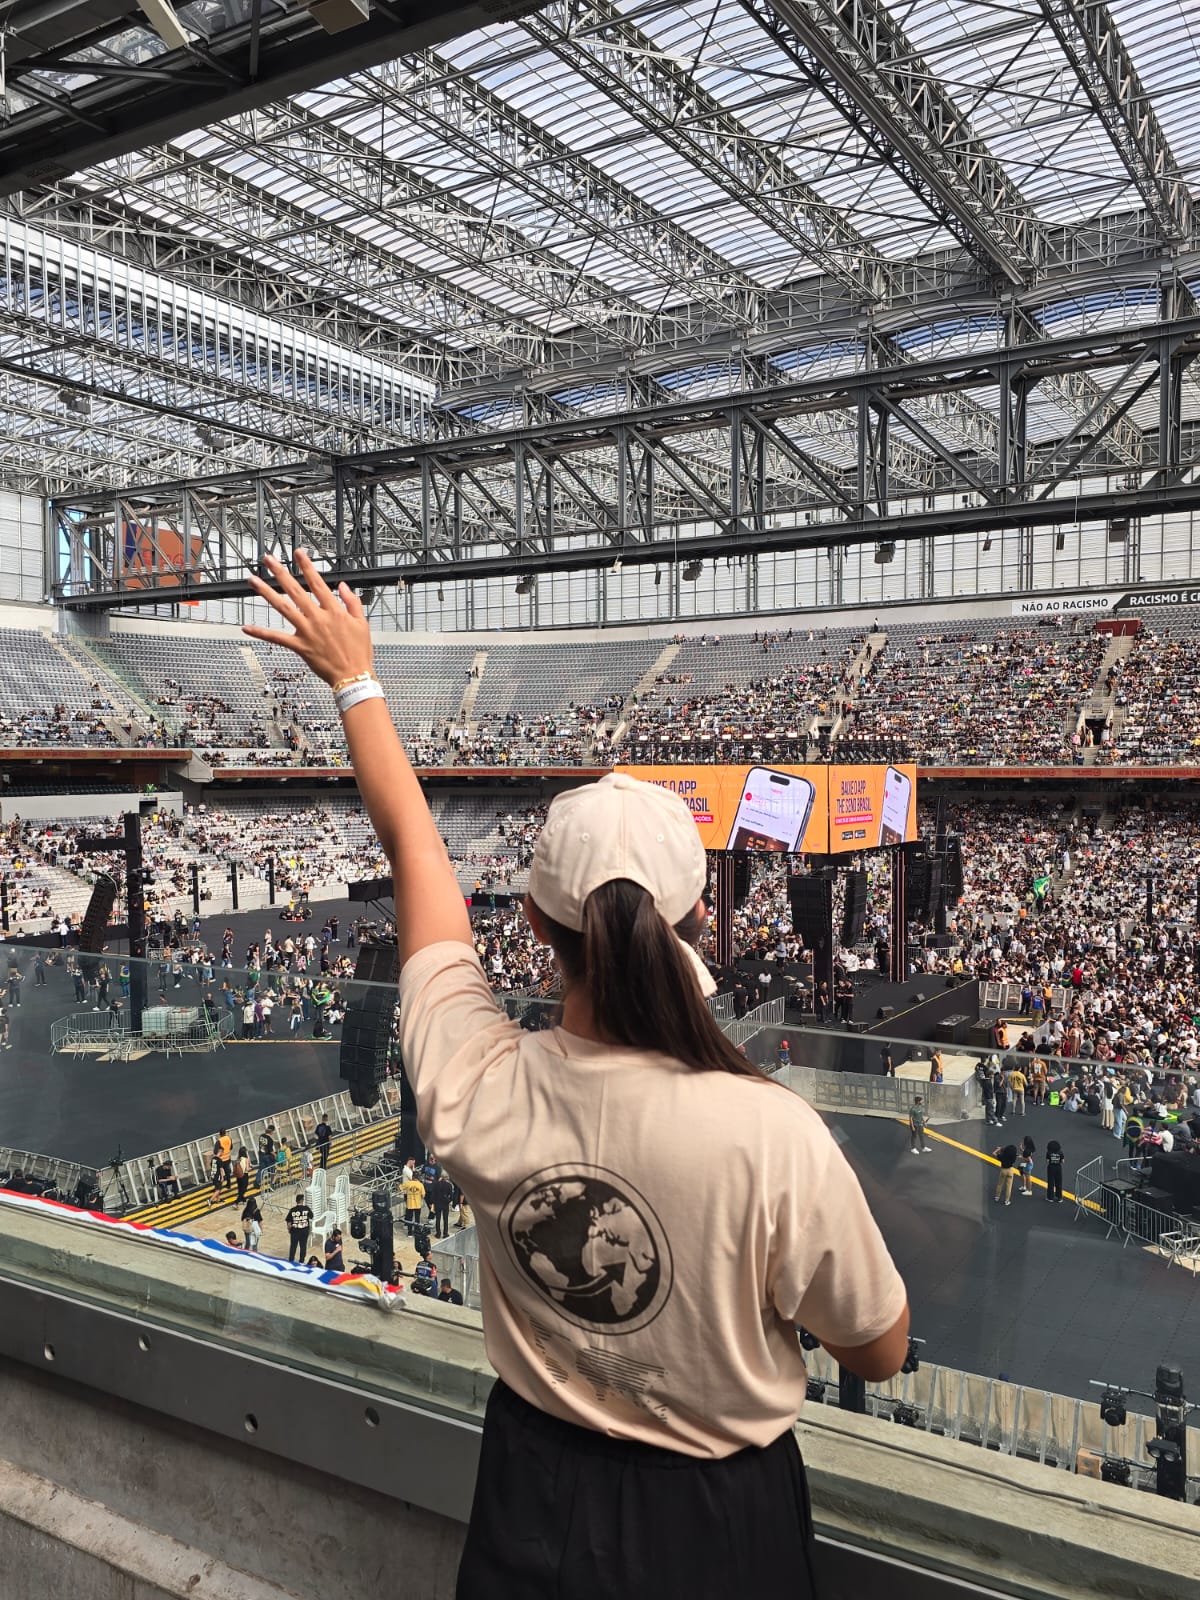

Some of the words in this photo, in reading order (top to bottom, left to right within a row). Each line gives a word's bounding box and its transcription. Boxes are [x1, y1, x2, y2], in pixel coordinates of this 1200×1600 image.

[1130, 594, 1178, 605] RACISMO
[1181, 590, 1188, 602] É
[1022, 601, 1043, 612] NÃO
[1046, 602, 1060, 611] AO
[1063, 599, 1108, 610] RACISMO
[678, 780, 697, 794] APP
[836, 799, 845, 814] THE
